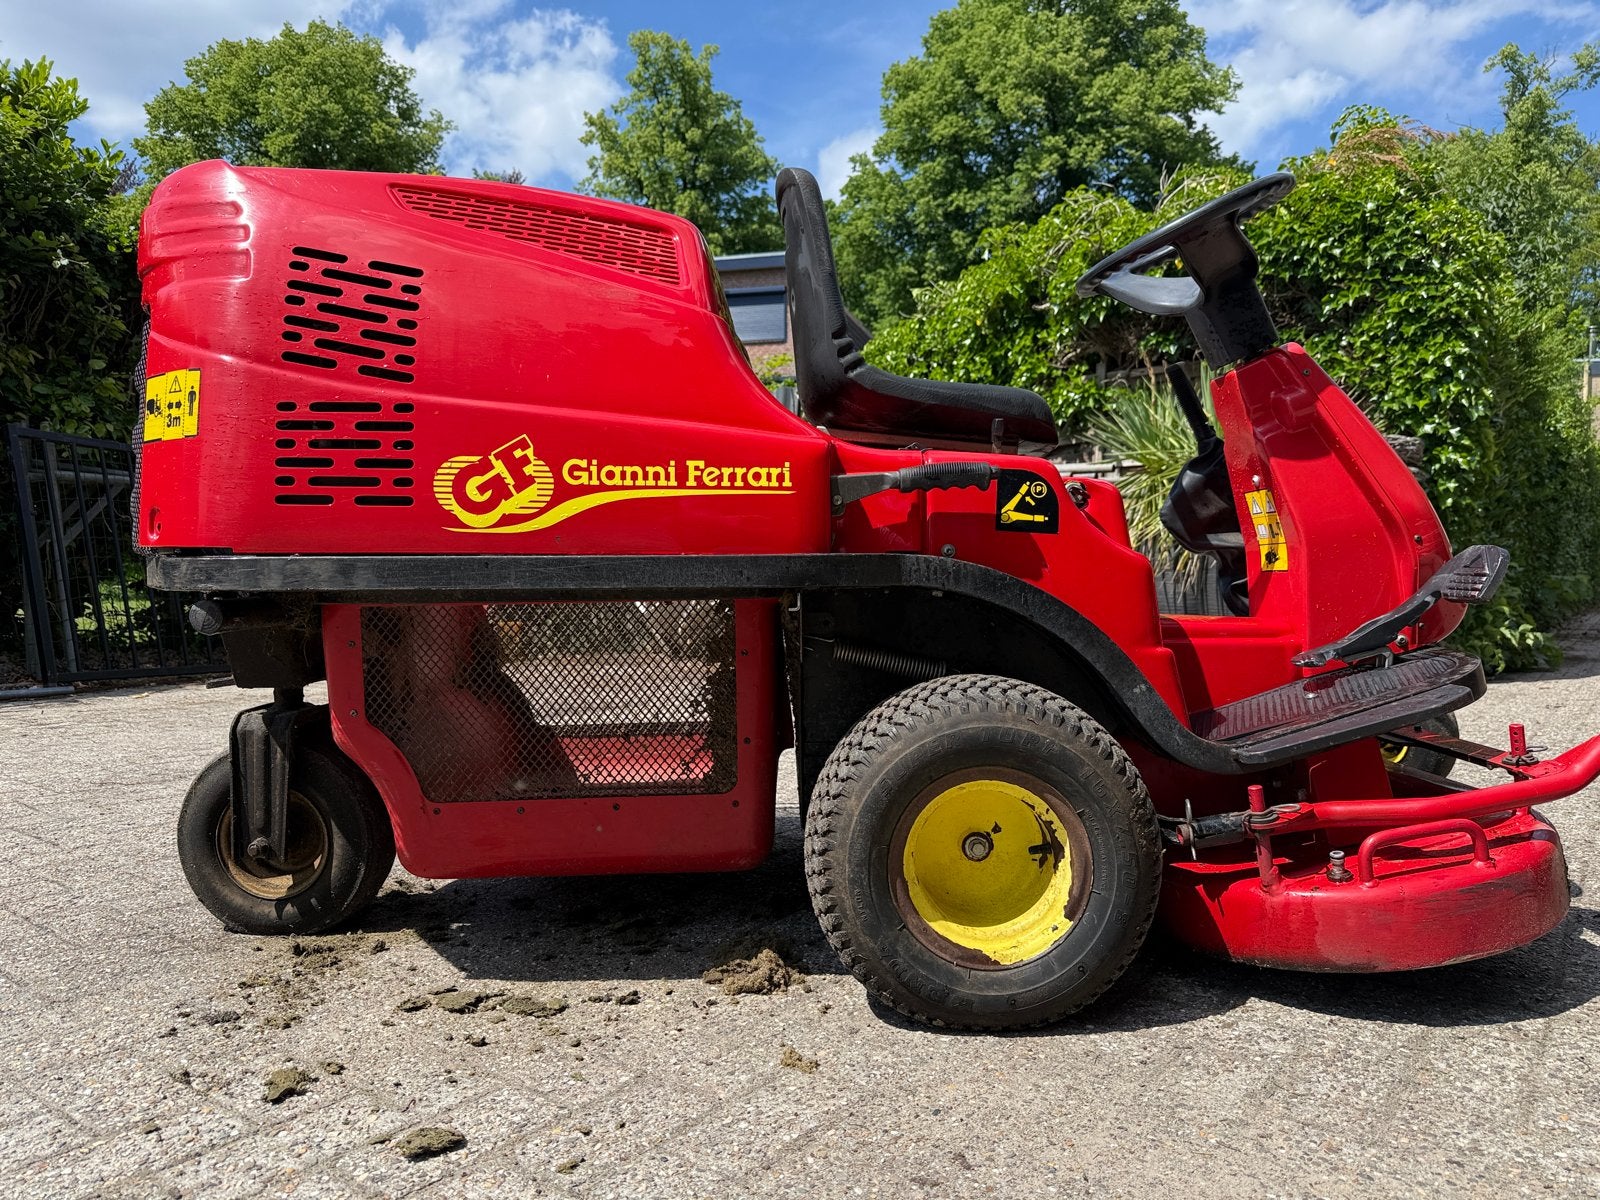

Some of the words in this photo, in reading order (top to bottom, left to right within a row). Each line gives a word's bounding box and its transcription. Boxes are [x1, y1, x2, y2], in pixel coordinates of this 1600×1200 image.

[166, 413, 181, 428] 3m
[562, 458, 677, 487] Gianni
[686, 460, 793, 488] Ferrari
